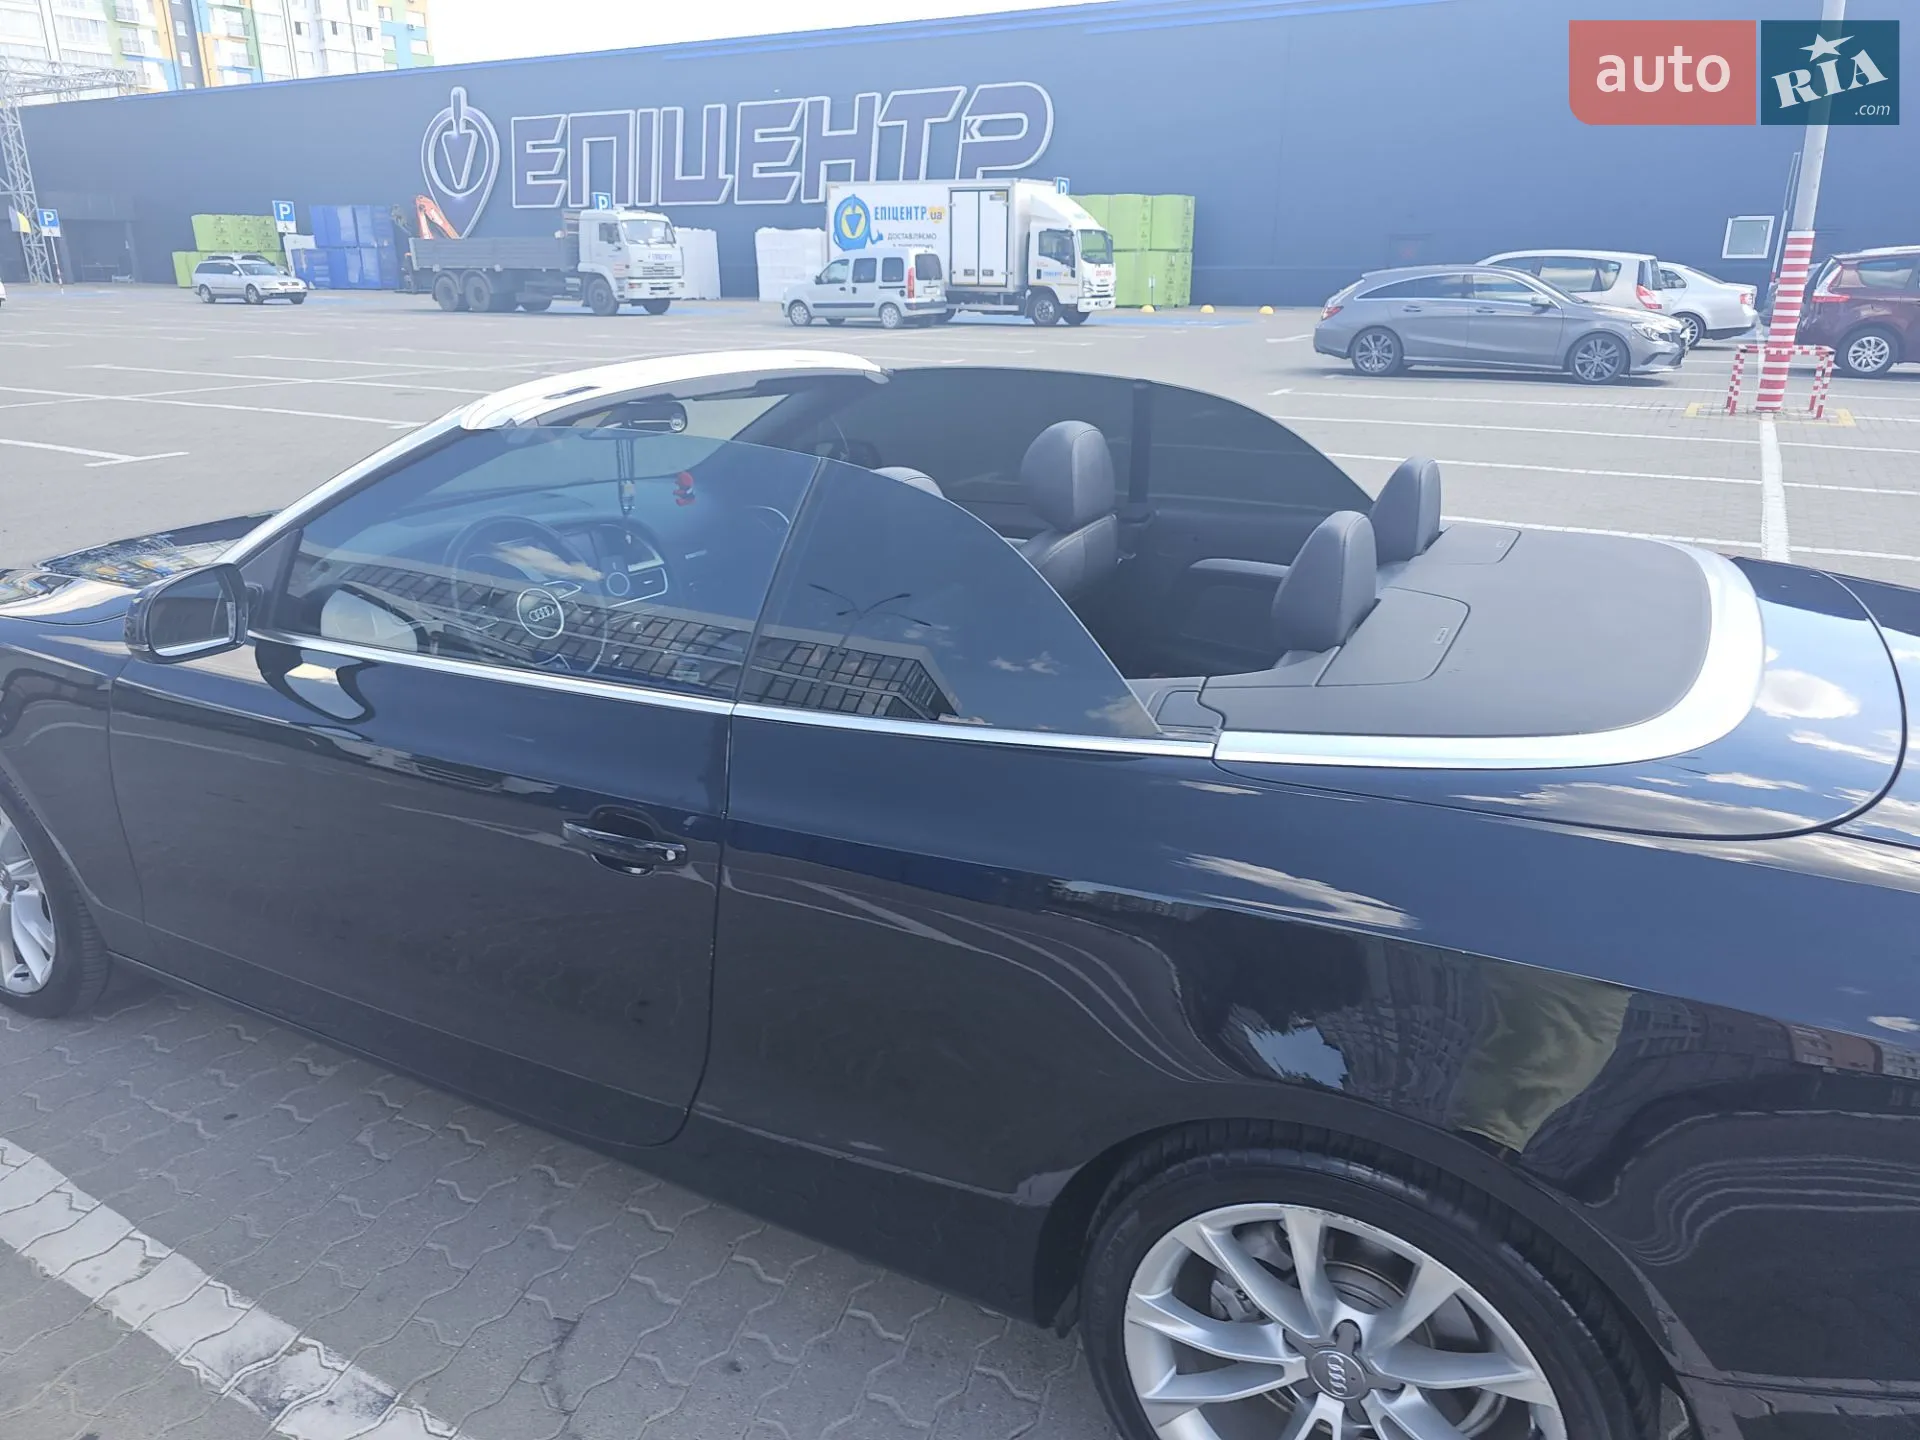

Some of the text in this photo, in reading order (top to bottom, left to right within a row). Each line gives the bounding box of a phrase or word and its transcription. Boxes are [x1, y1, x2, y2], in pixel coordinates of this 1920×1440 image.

[511, 82, 1054, 208] ЕПІЦЕНТР
[43, 211, 55, 226] P
[279, 203, 291, 220] P
